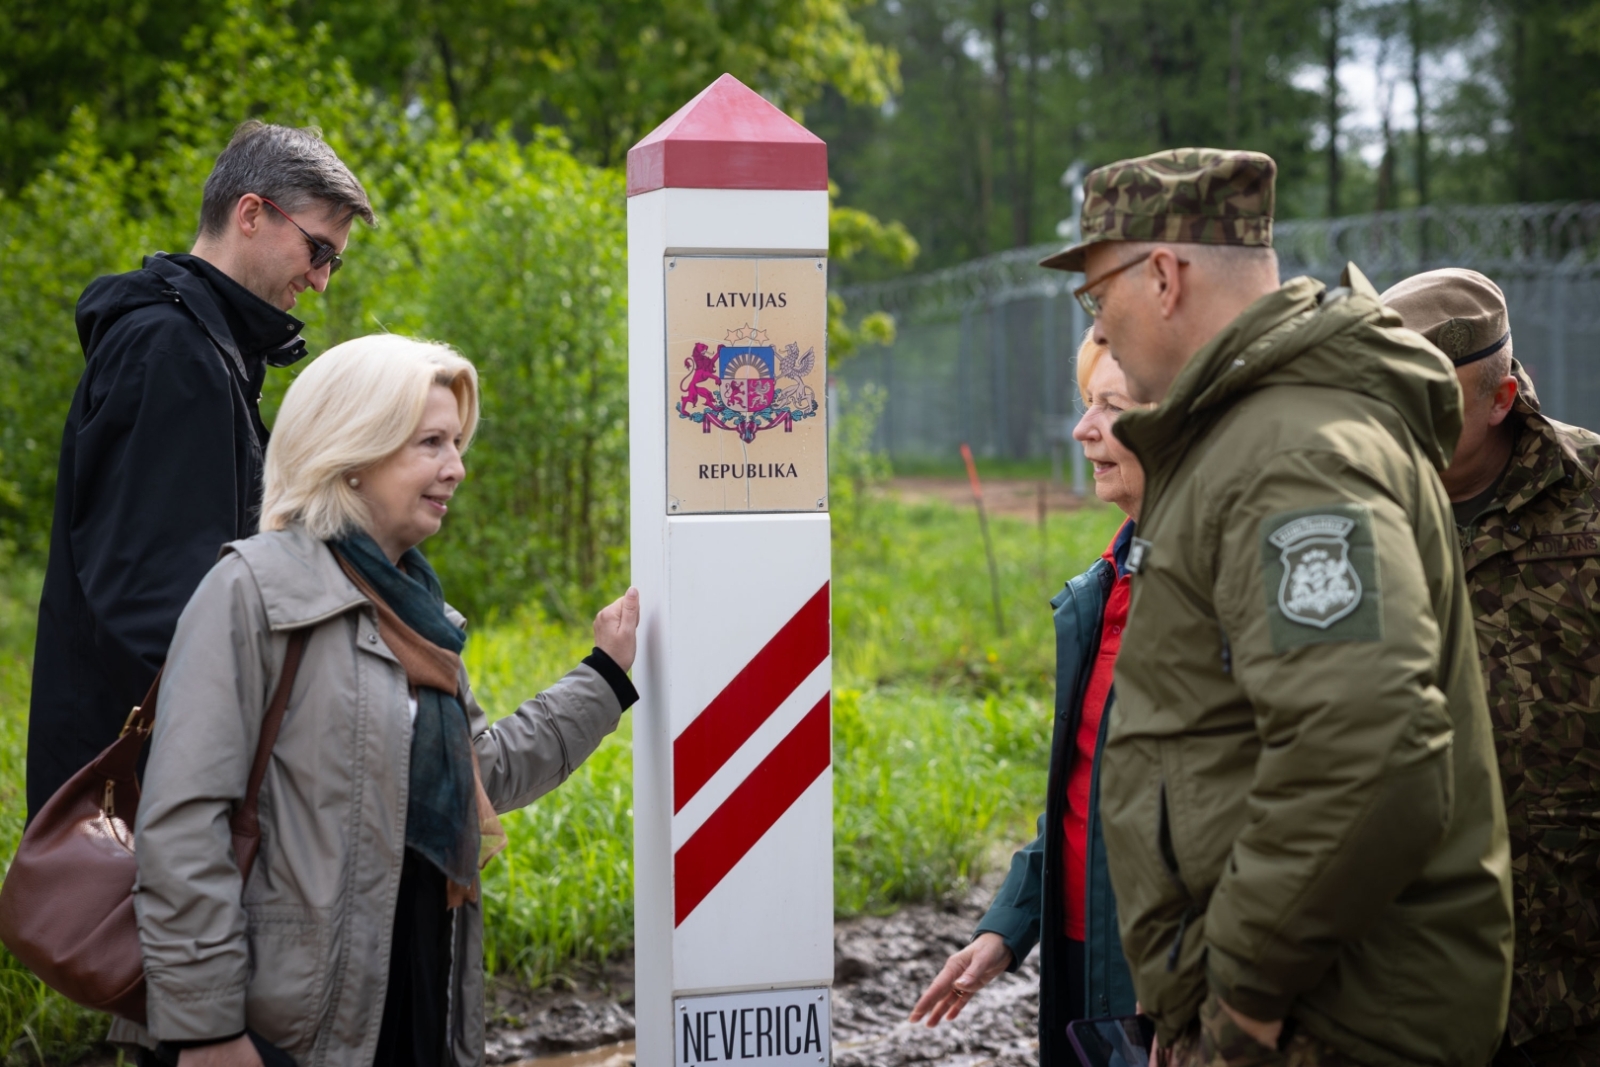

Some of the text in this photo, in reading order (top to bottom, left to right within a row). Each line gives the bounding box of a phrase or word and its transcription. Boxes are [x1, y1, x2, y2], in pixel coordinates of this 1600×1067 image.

[706, 293, 787, 310] LATVIJAS
[699, 463, 798, 479] REPUBLIKA
[683, 1003, 822, 1063] NEVERICA
